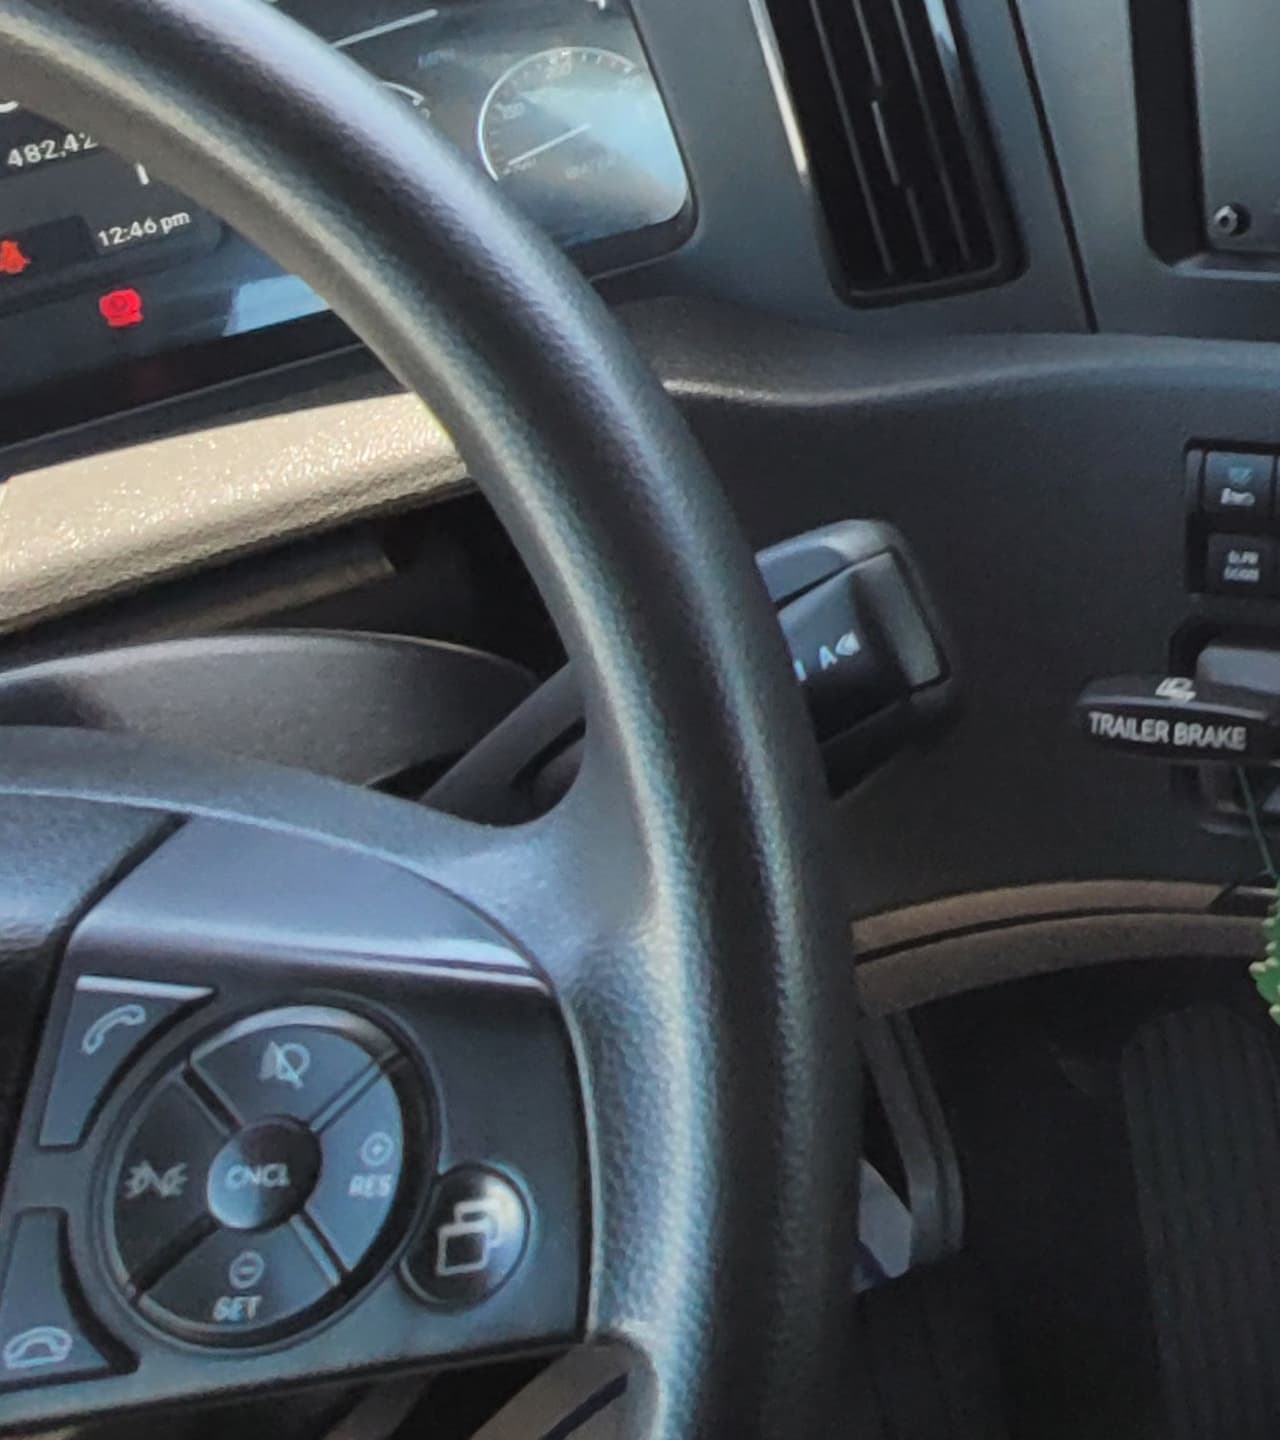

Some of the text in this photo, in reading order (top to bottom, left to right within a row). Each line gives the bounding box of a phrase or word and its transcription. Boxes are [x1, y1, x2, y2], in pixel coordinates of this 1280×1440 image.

[98, 211, 191, 248] 12:46 pm
[1088, 711, 1248, 751] TRAILER BRAKE
[225, 1163, 290, 1190] CNCL
[348, 1173, 393, 1198] RES
[213, 1295, 262, 1322] SET
